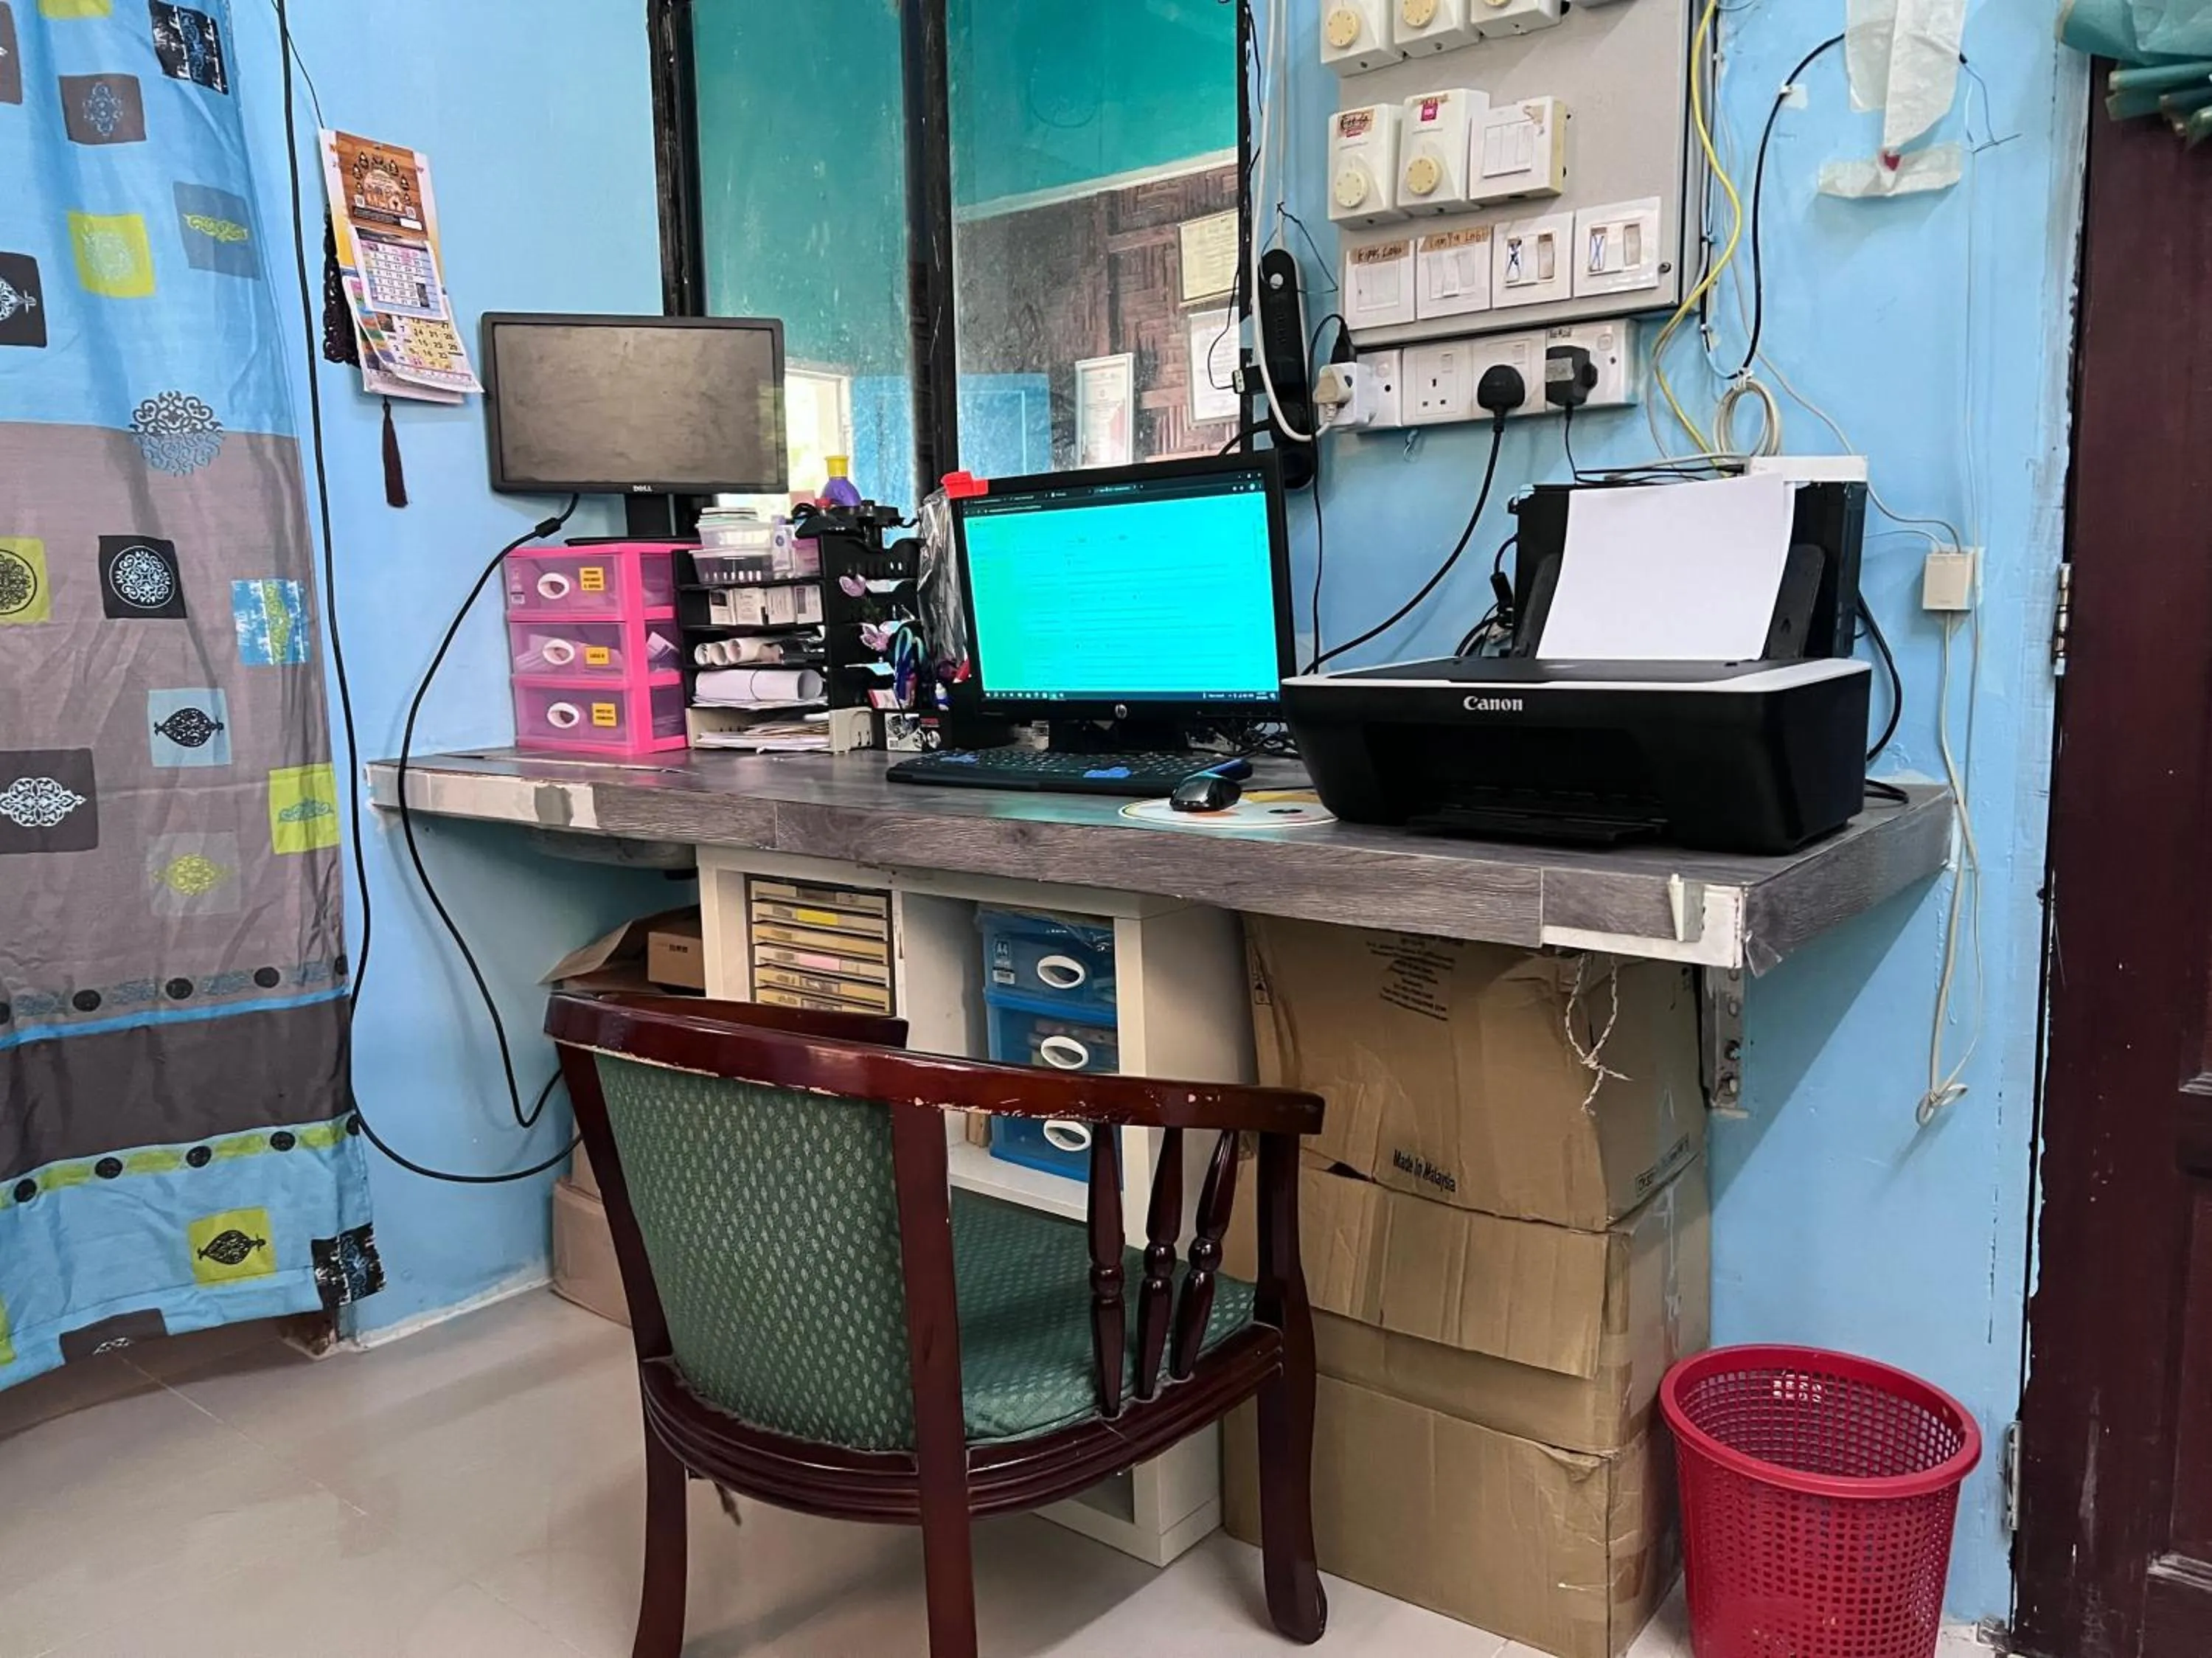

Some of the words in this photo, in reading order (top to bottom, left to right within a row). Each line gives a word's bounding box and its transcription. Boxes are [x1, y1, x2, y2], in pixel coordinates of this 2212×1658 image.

[633, 485, 653, 493] DELL
[1463, 696, 1523, 712] Canon
[1393, 1148, 1413, 1173] Made
[1422, 1162, 1456, 1193] Malaysia
